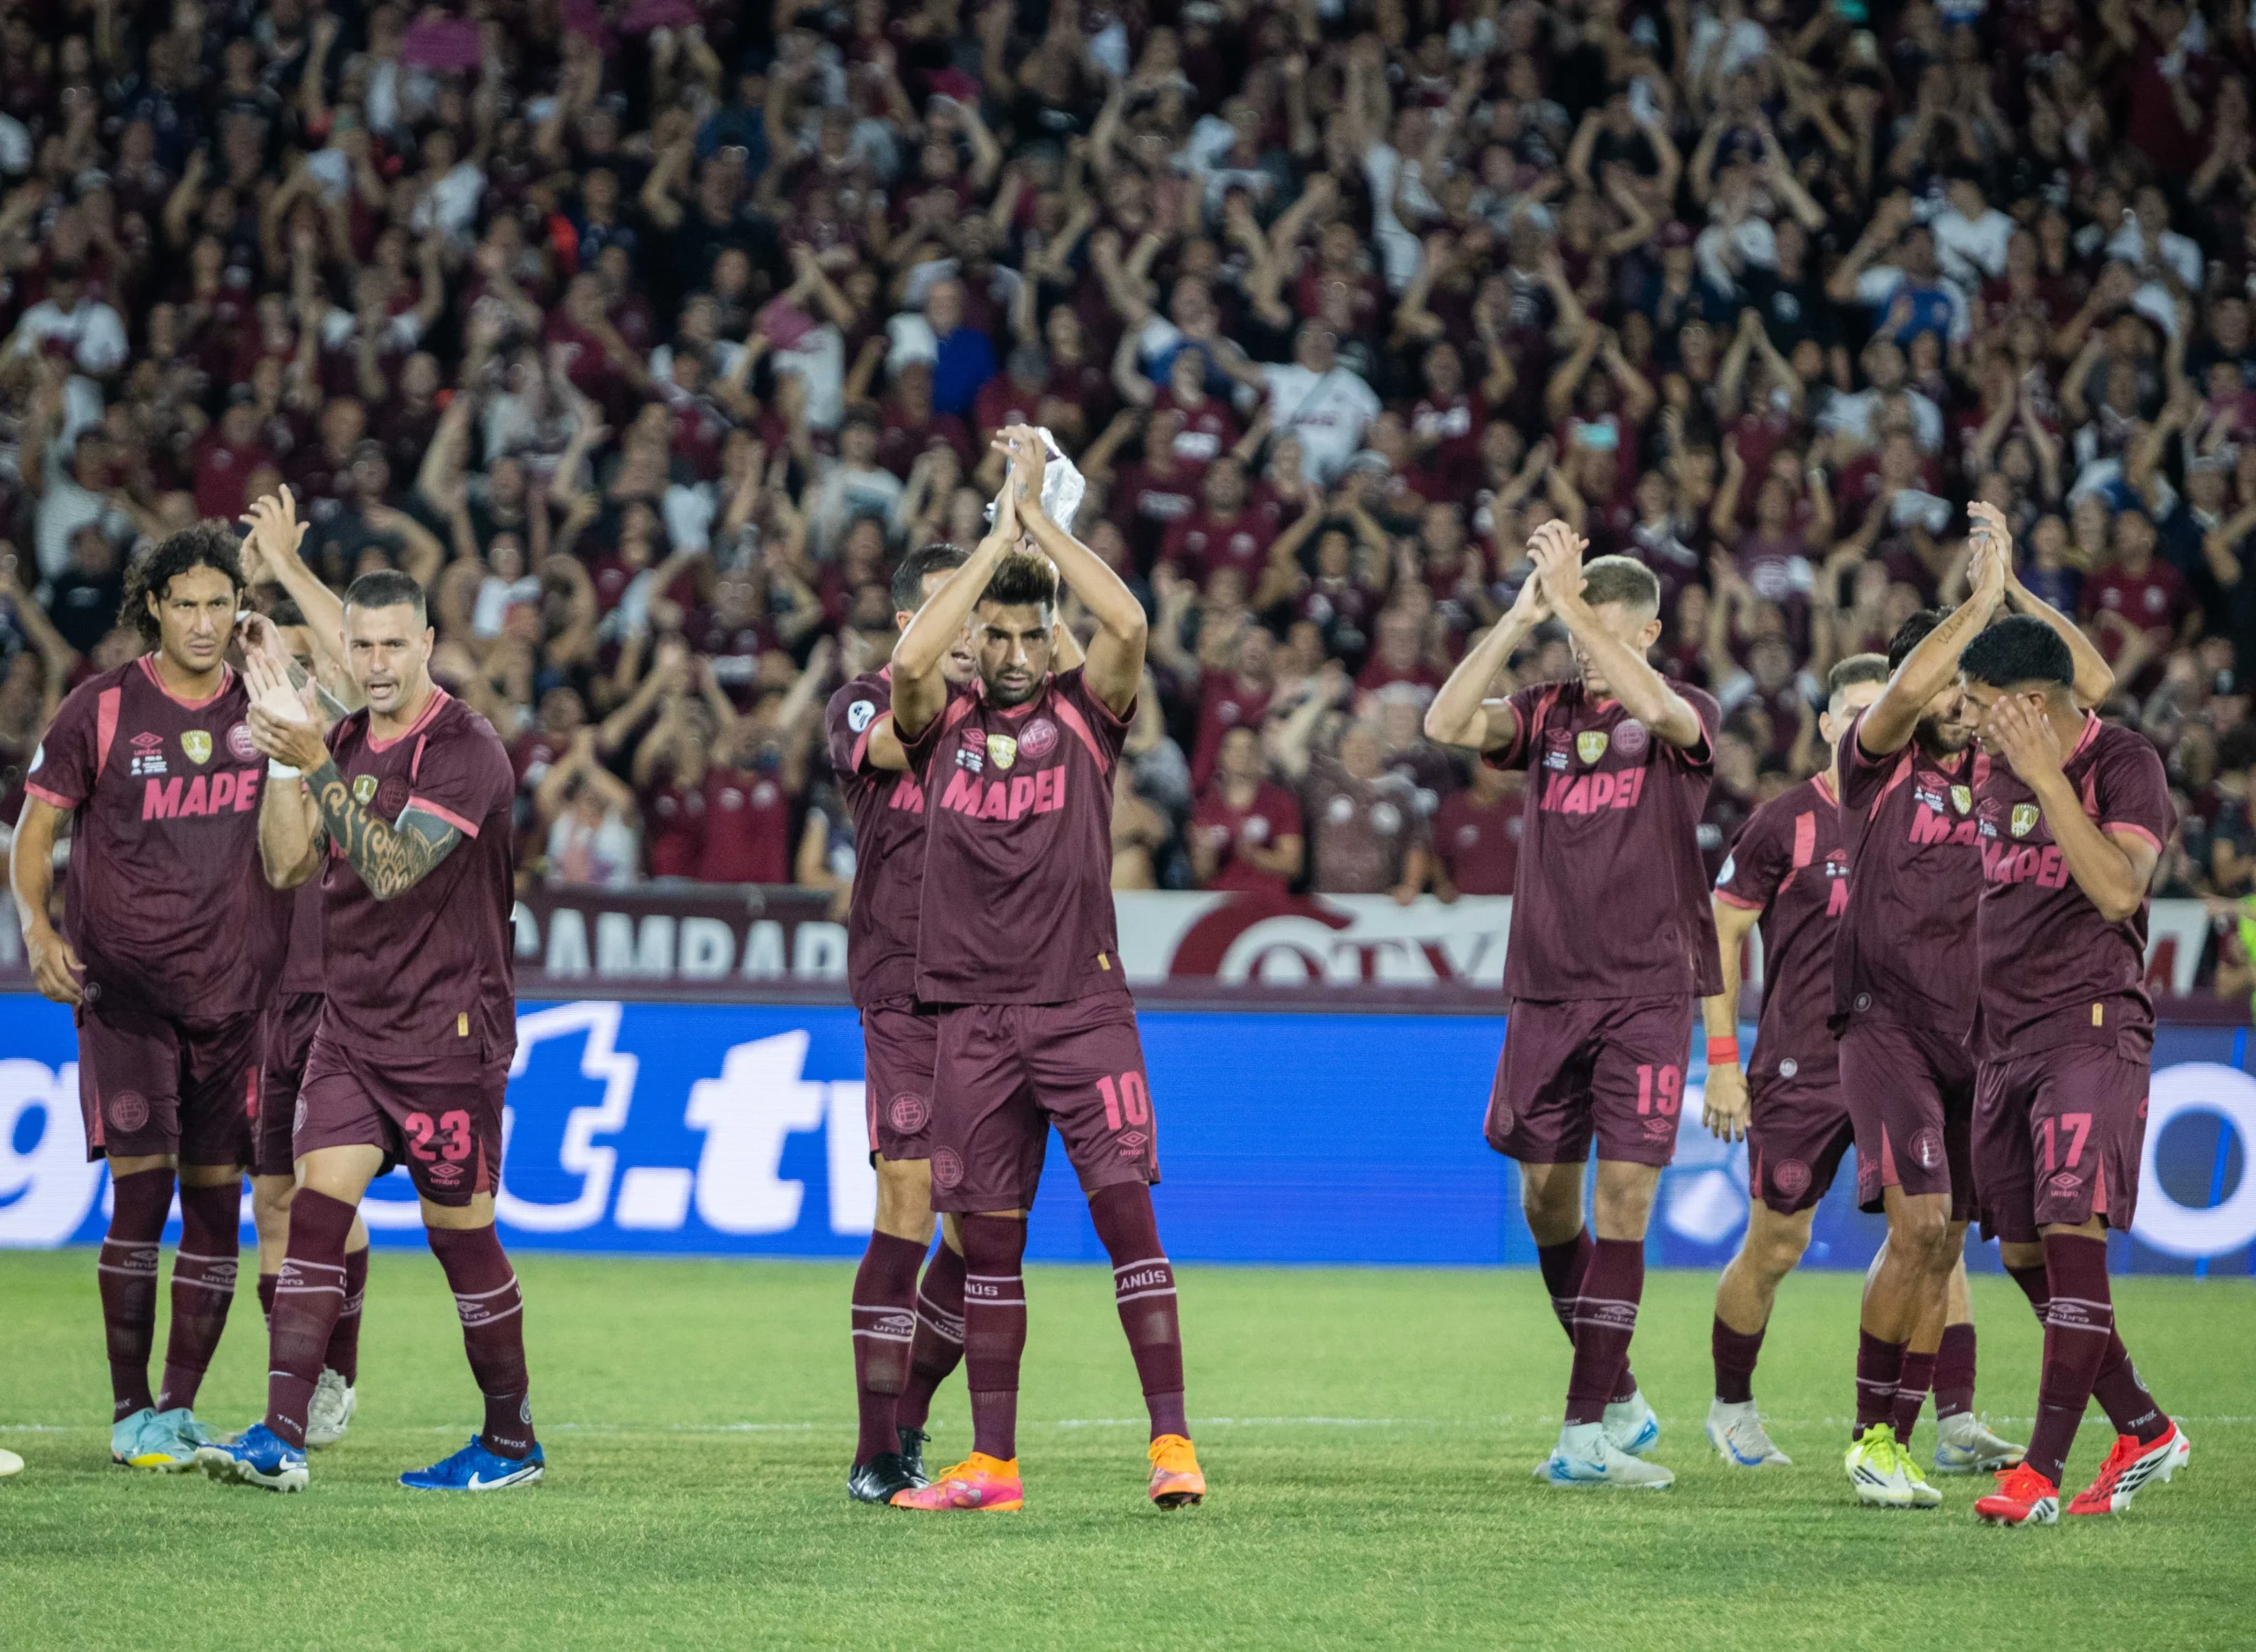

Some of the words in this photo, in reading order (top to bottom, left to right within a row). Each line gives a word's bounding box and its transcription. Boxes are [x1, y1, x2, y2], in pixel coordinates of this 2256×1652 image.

[142, 769, 260, 821] MAPE
[939, 765, 1065, 820] MAPEI
[1540, 767, 1646, 814] MAPEI
[1095, 1070, 1148, 1130] 10
[1636, 1064, 1681, 1115] 19
[405, 1109, 471, 1161] 23
[2043, 1113, 2092, 1170] 17
